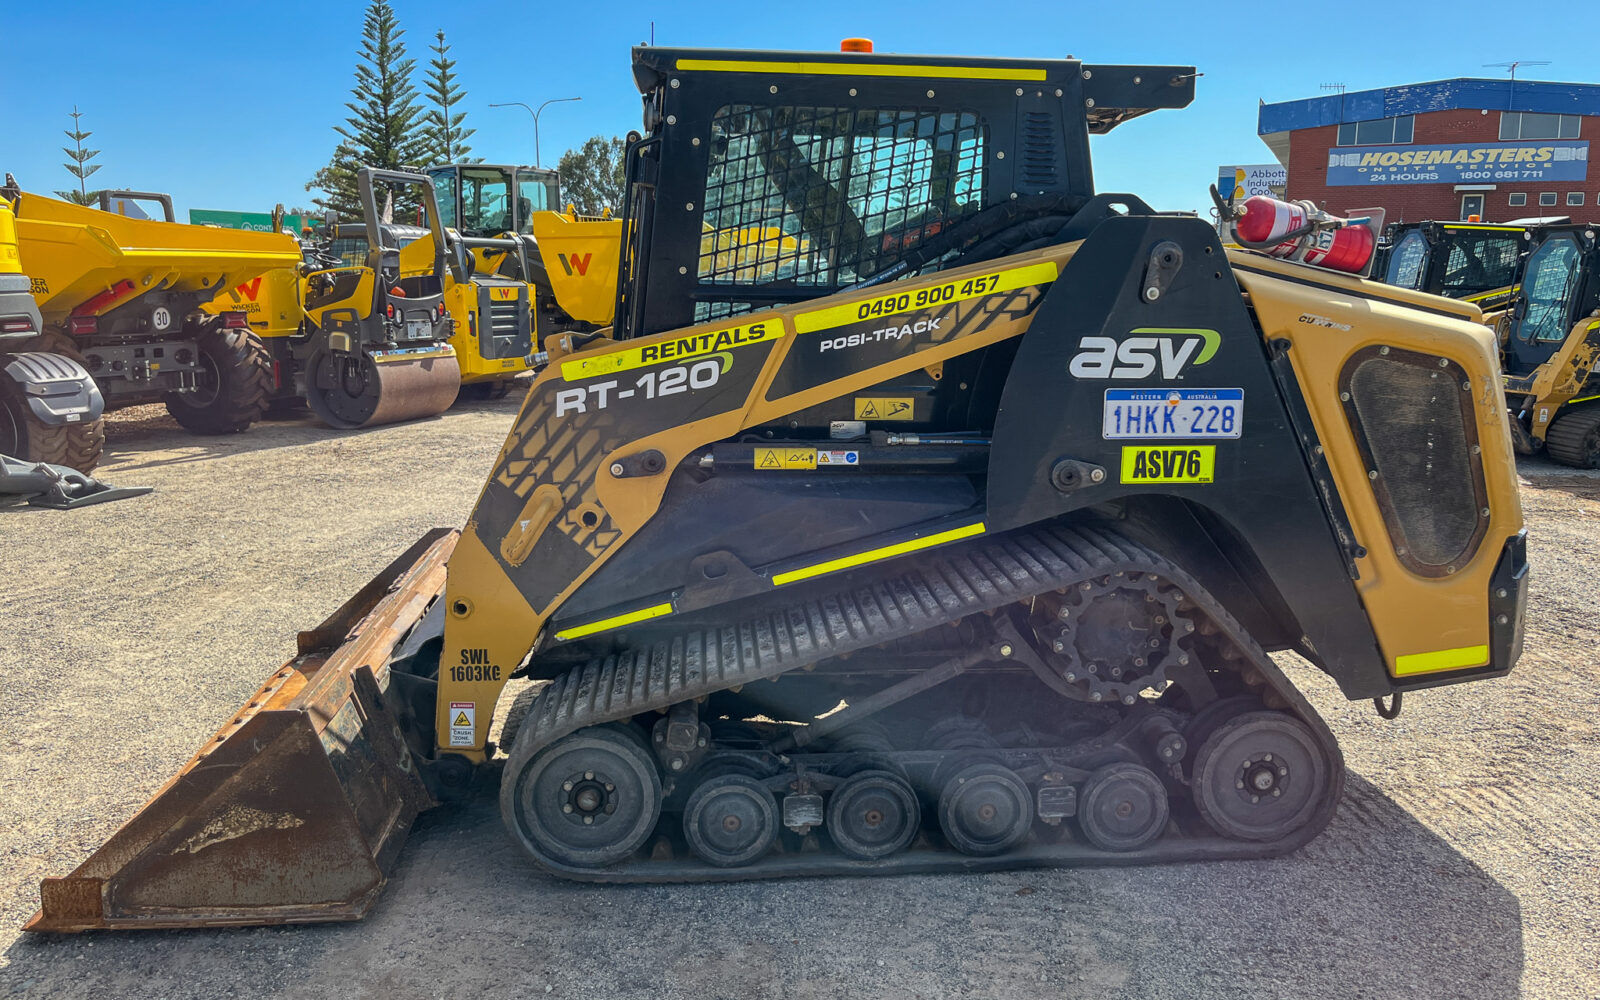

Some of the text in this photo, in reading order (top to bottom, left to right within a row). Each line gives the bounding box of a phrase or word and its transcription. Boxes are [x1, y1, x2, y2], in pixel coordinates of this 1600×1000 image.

[1360, 147, 1555, 167] HOSEMASTERS
[1357, 162, 1553, 173] ONSITE SERVICE
[1370, 174, 1387, 182] 24
[1391, 172, 1439, 181] HOURS
[1460, 171, 1491, 179] 1800
[1494, 170, 1518, 178] 681
[1247, 179, 1287, 187] Industria
[858, 274, 1000, 319] 0490 900 457
[156, 311, 168, 326] 30
[641, 324, 766, 363] RENTALS
[819, 316, 943, 353] POSI-TRACK
[1069, 336, 1200, 379] asv
[556, 360, 720, 418] RT-120
[1132, 450, 1201, 478] ASV76
[460, 649, 490, 665] SWL
[449, 665, 501, 682] 1603KG
